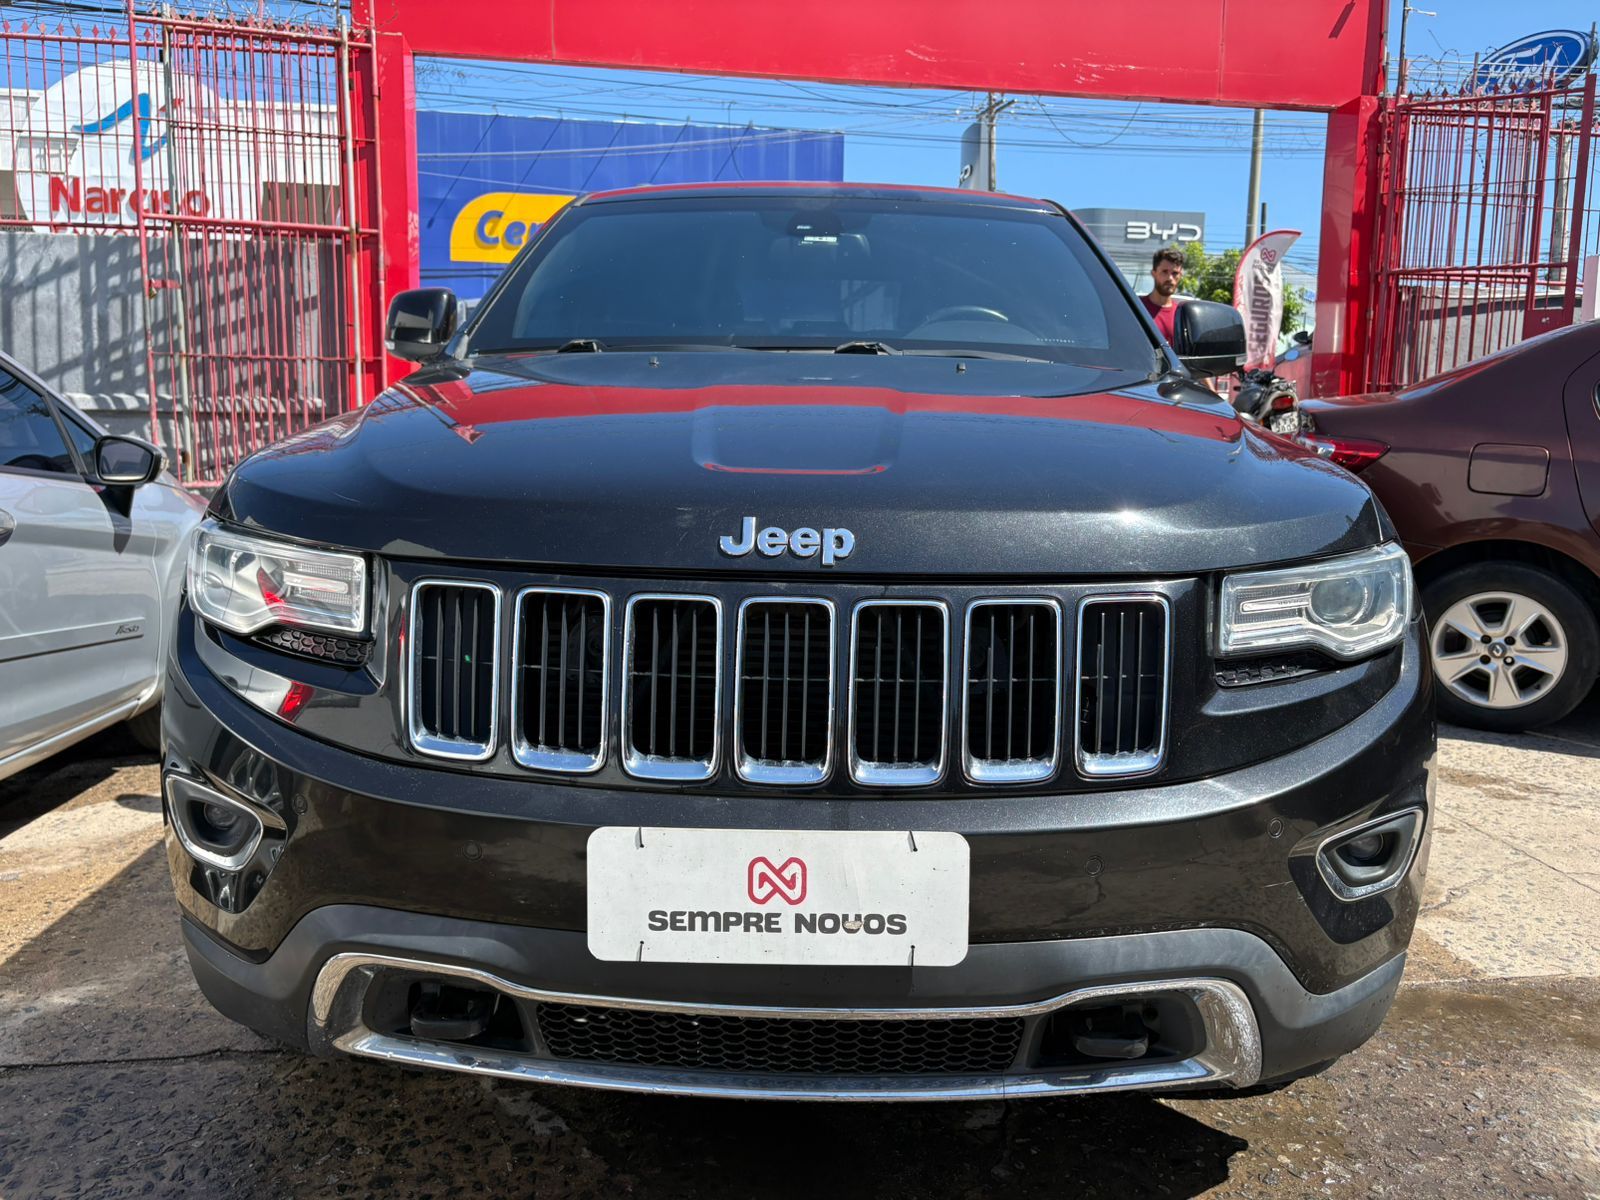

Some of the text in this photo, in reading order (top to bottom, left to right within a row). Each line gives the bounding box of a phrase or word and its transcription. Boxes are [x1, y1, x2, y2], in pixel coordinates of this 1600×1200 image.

[1126, 221, 1202, 241] BYD
[719, 516, 855, 566] Jeep
[648, 909, 782, 933] SEMPRE
